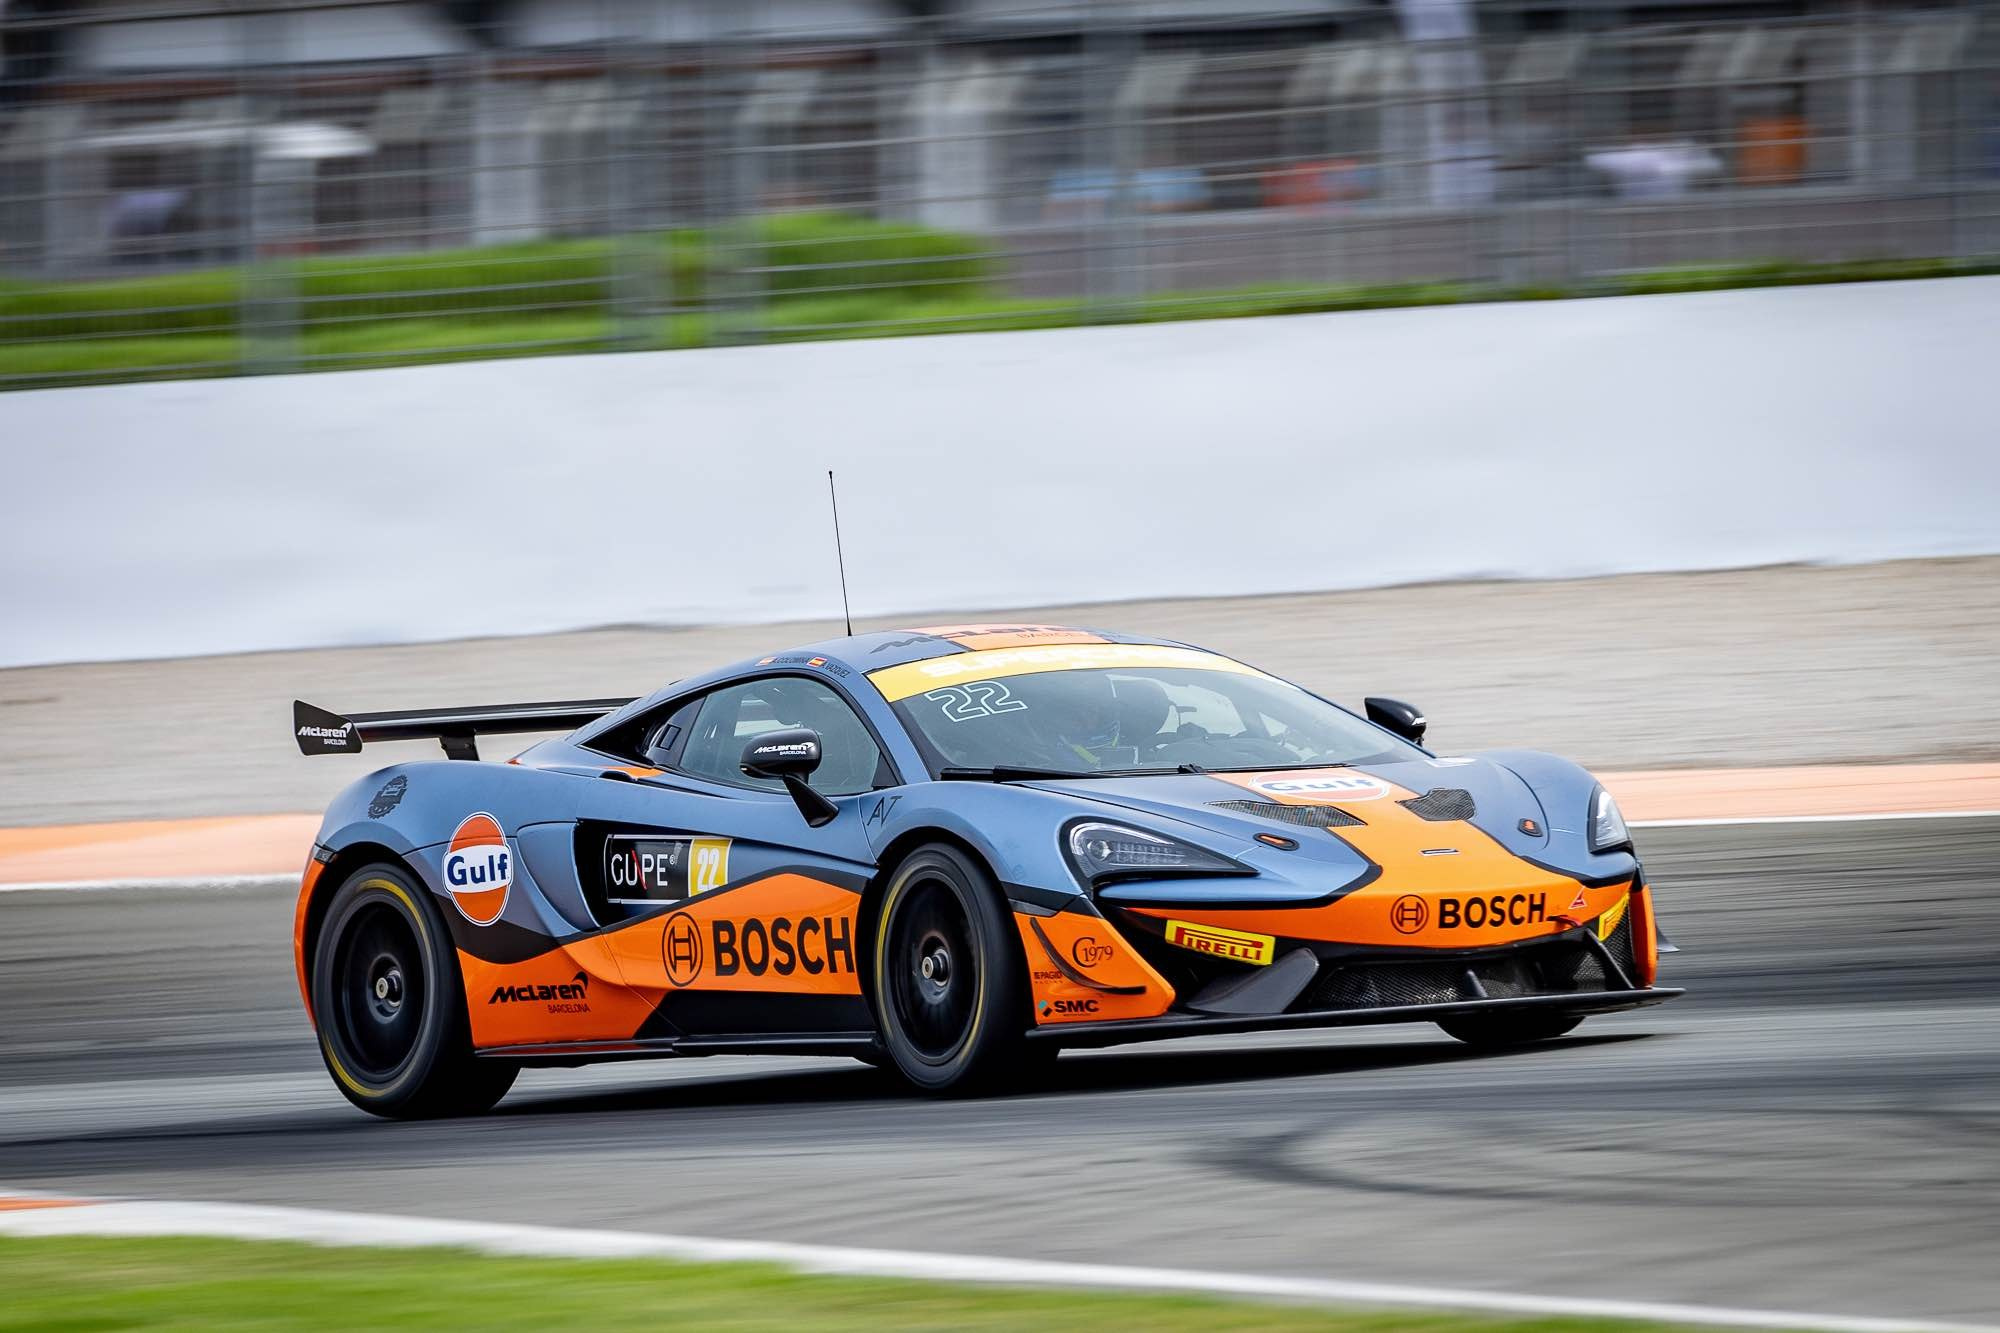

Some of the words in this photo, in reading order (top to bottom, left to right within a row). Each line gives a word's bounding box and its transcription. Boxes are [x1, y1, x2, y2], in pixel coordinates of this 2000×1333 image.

[924, 680, 1028, 722] 22
[297, 725, 347, 738] McLaren
[753, 744, 807, 754] McLaren
[1261, 778, 1376, 791] Gulf
[447, 853, 508, 886] Gulf
[697, 847, 720, 892] 22
[1438, 892, 1547, 929] BOSCH
[712, 916, 856, 977] BOSCH
[1174, 925, 1264, 961] PIRELLI
[487, 983, 586, 1005] McLaren
[1053, 999, 1100, 1013] SMC
[547, 1002, 592, 1014] BARCELONA
